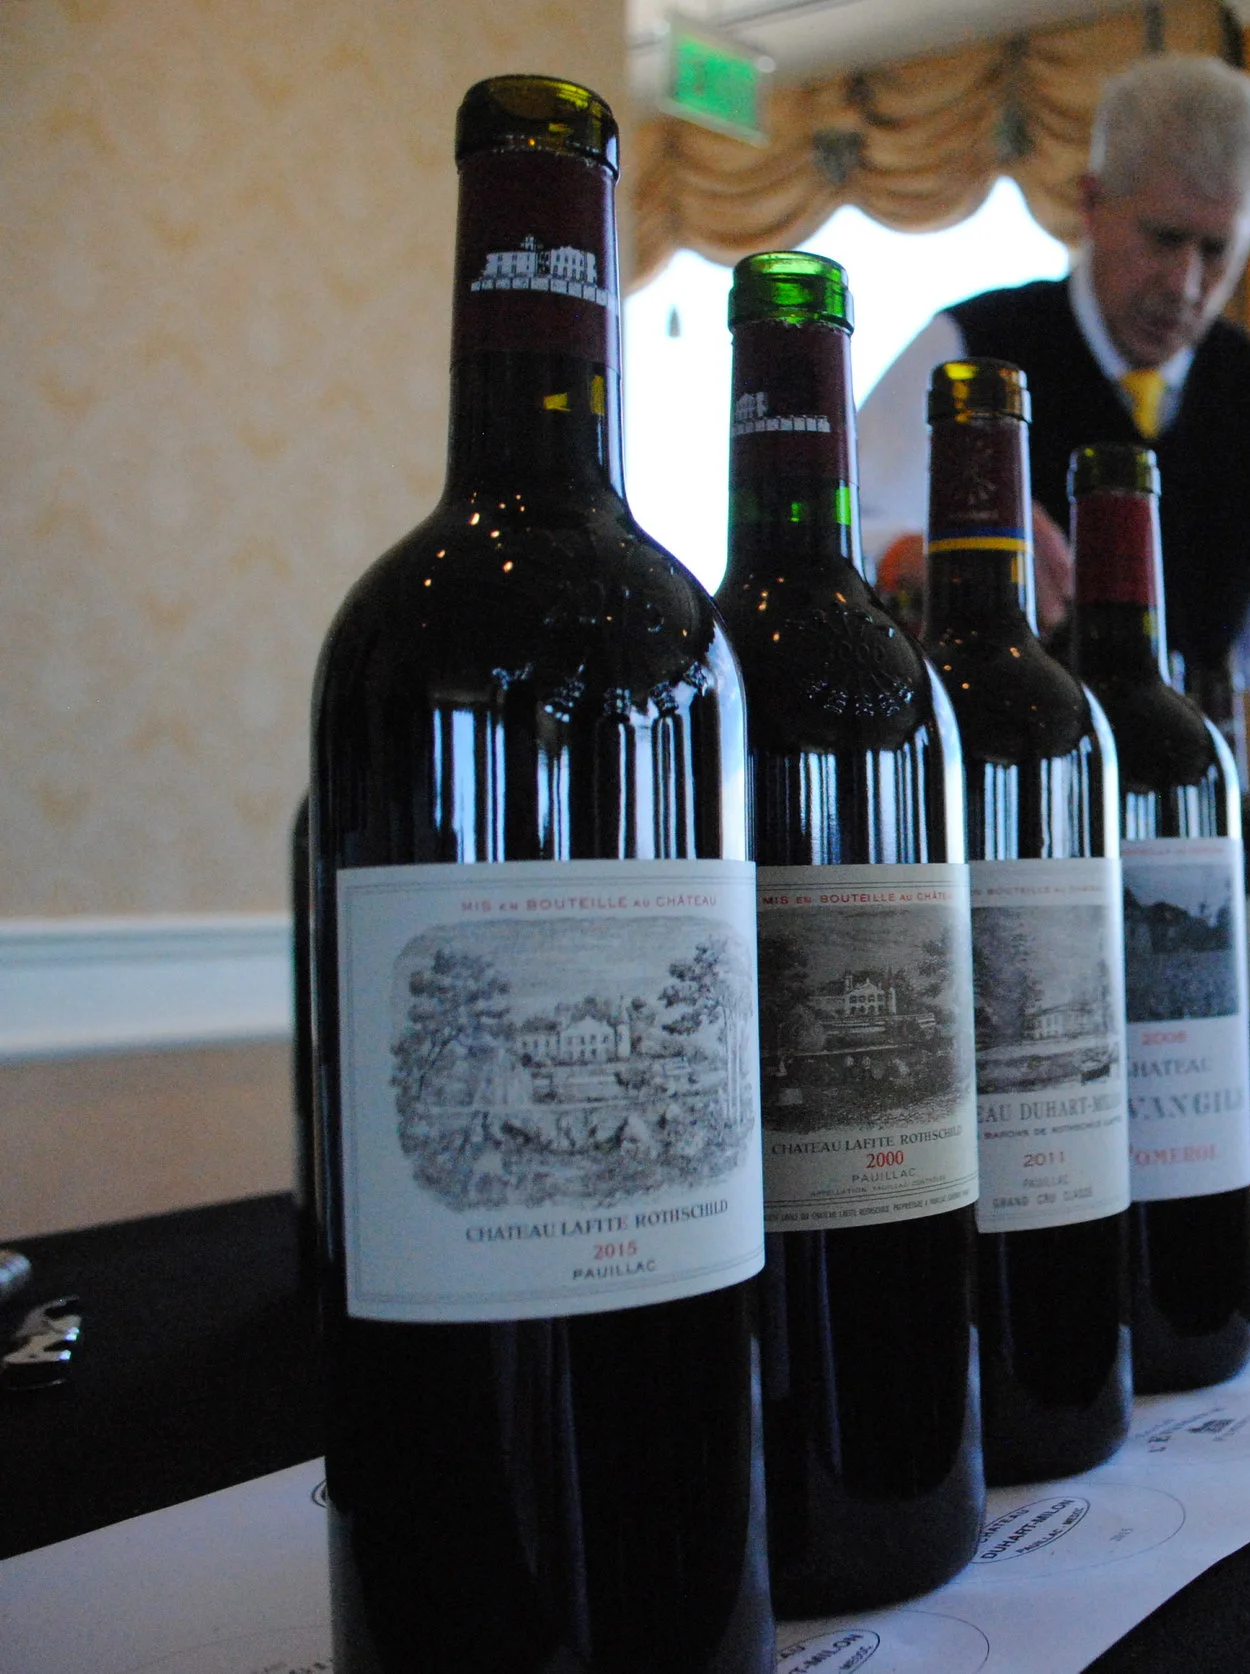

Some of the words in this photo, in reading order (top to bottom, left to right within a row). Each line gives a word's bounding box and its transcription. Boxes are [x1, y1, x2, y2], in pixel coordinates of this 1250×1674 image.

[460, 902, 492, 912] MIS
[525, 896, 628, 911] BOUTEILLE
[632, 899, 651, 907] AU
[762, 895, 789, 905] MIS
[796, 896, 812, 904] EN
[820, 893, 896, 904] BOUTEILLE
[1128, 1058, 1213, 1078] HATEAU
[771, 1140, 842, 1155] CHATEAU
[845, 1138, 895, 1151] LAFITE
[900, 1124, 963, 1146] ROTHSCHILD
[865, 1150, 905, 1169] 2000
[1023, 1151, 1066, 1168] 2011
[1128, 1144, 1216, 1165] OMEROL
[851, 1167, 917, 1184] PAUILLAC
[465, 1225, 554, 1243] CHATEAU
[559, 1216, 628, 1237] LAFITE
[635, 1198, 728, 1230] ROTHSCHILD
[593, 1241, 638, 1260] 2015
[572, 1259, 656, 1281] PAUILLAC
